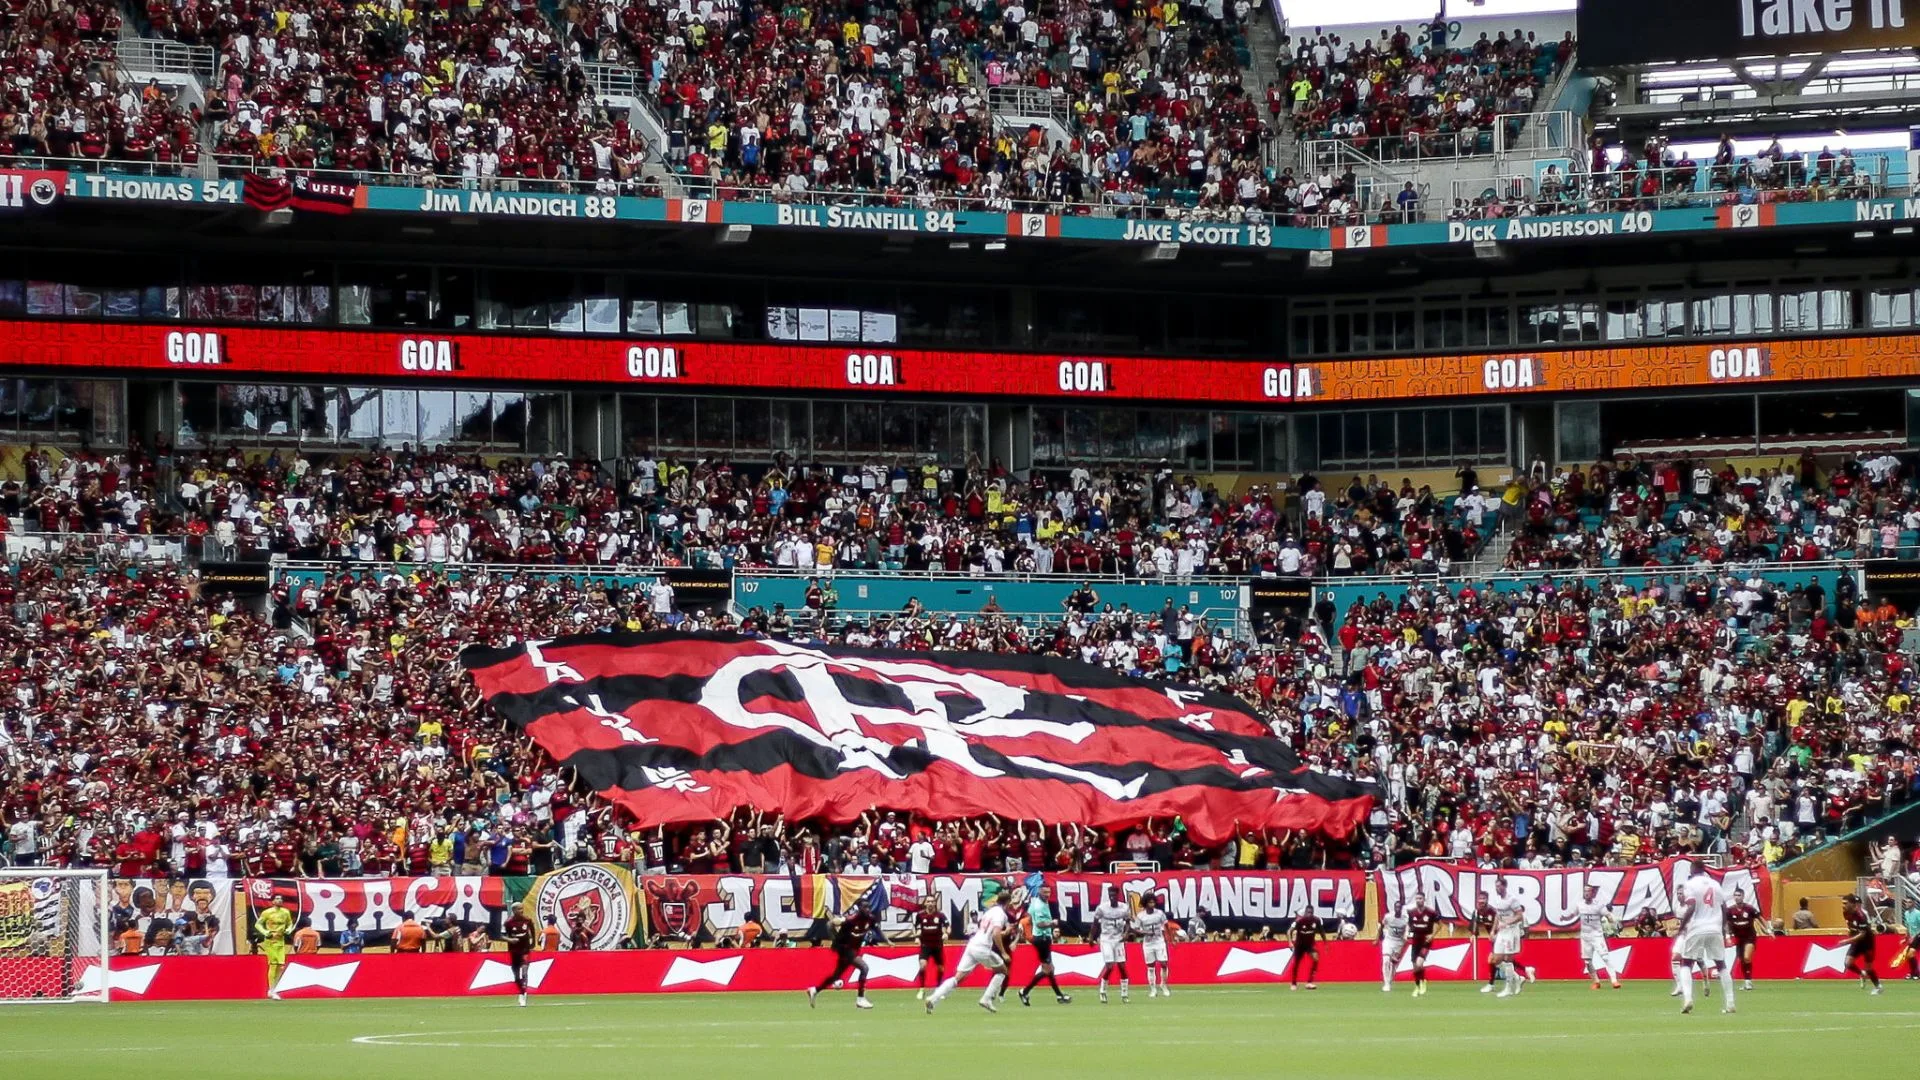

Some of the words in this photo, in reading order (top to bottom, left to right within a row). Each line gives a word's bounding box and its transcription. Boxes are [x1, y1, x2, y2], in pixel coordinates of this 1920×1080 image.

[1418, 21, 1462, 45] 39
[86, 175, 194, 201] THOMAS
[202, 181, 238, 203] 54
[420, 189, 461, 212] JIM
[468, 192, 577, 217] MANDICH
[584, 196, 616, 218] 88
[1856, 201, 1895, 221] NAT
[778, 204, 821, 227] BILL
[827, 206, 919, 231] STANFILL
[925, 212, 956, 233] 84
[1449, 222, 1497, 242] DICK
[1506, 218, 1613, 240] ANDERSON
[1621, 211, 1653, 233] 40
[1123, 219, 1172, 242] JAKE
[1178, 222, 1240, 245] SCOTT
[1247, 225, 1271, 247] 13
[741, 582, 759, 592] 107
[1220, 590, 1237, 600] 107
[1381, 858, 1761, 927] URUBUZAA
[1703, 887, 1714, 908] 4
